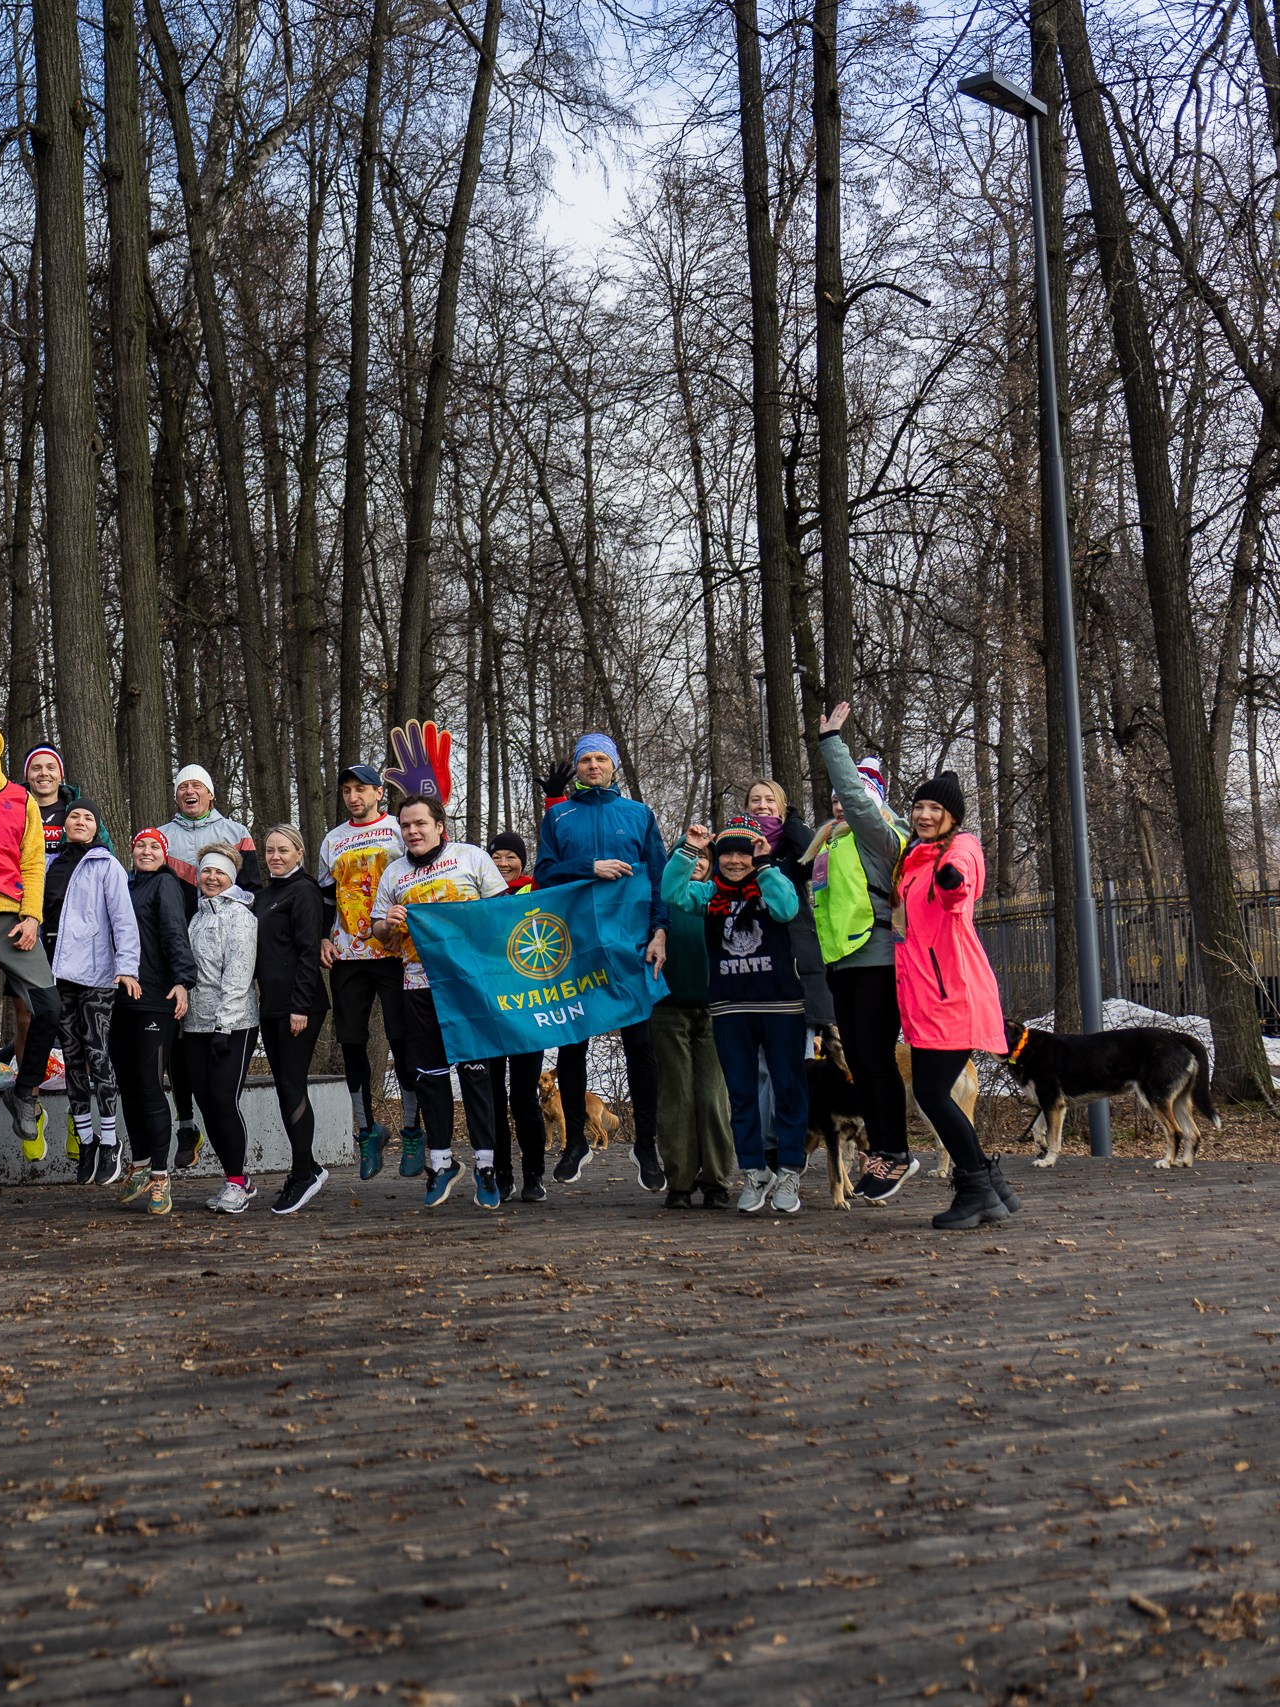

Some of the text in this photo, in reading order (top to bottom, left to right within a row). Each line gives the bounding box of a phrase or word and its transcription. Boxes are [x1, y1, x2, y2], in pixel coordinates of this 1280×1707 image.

[333, 827, 393, 852] БЕЗ ГРАНИЦ
[397, 858, 458, 885] БЕЗ ГРАНИЦ
[720, 956, 772, 975] STATE
[497, 968, 609, 1011] КУЛИБИН
[533, 1001, 585, 1028] RUN
